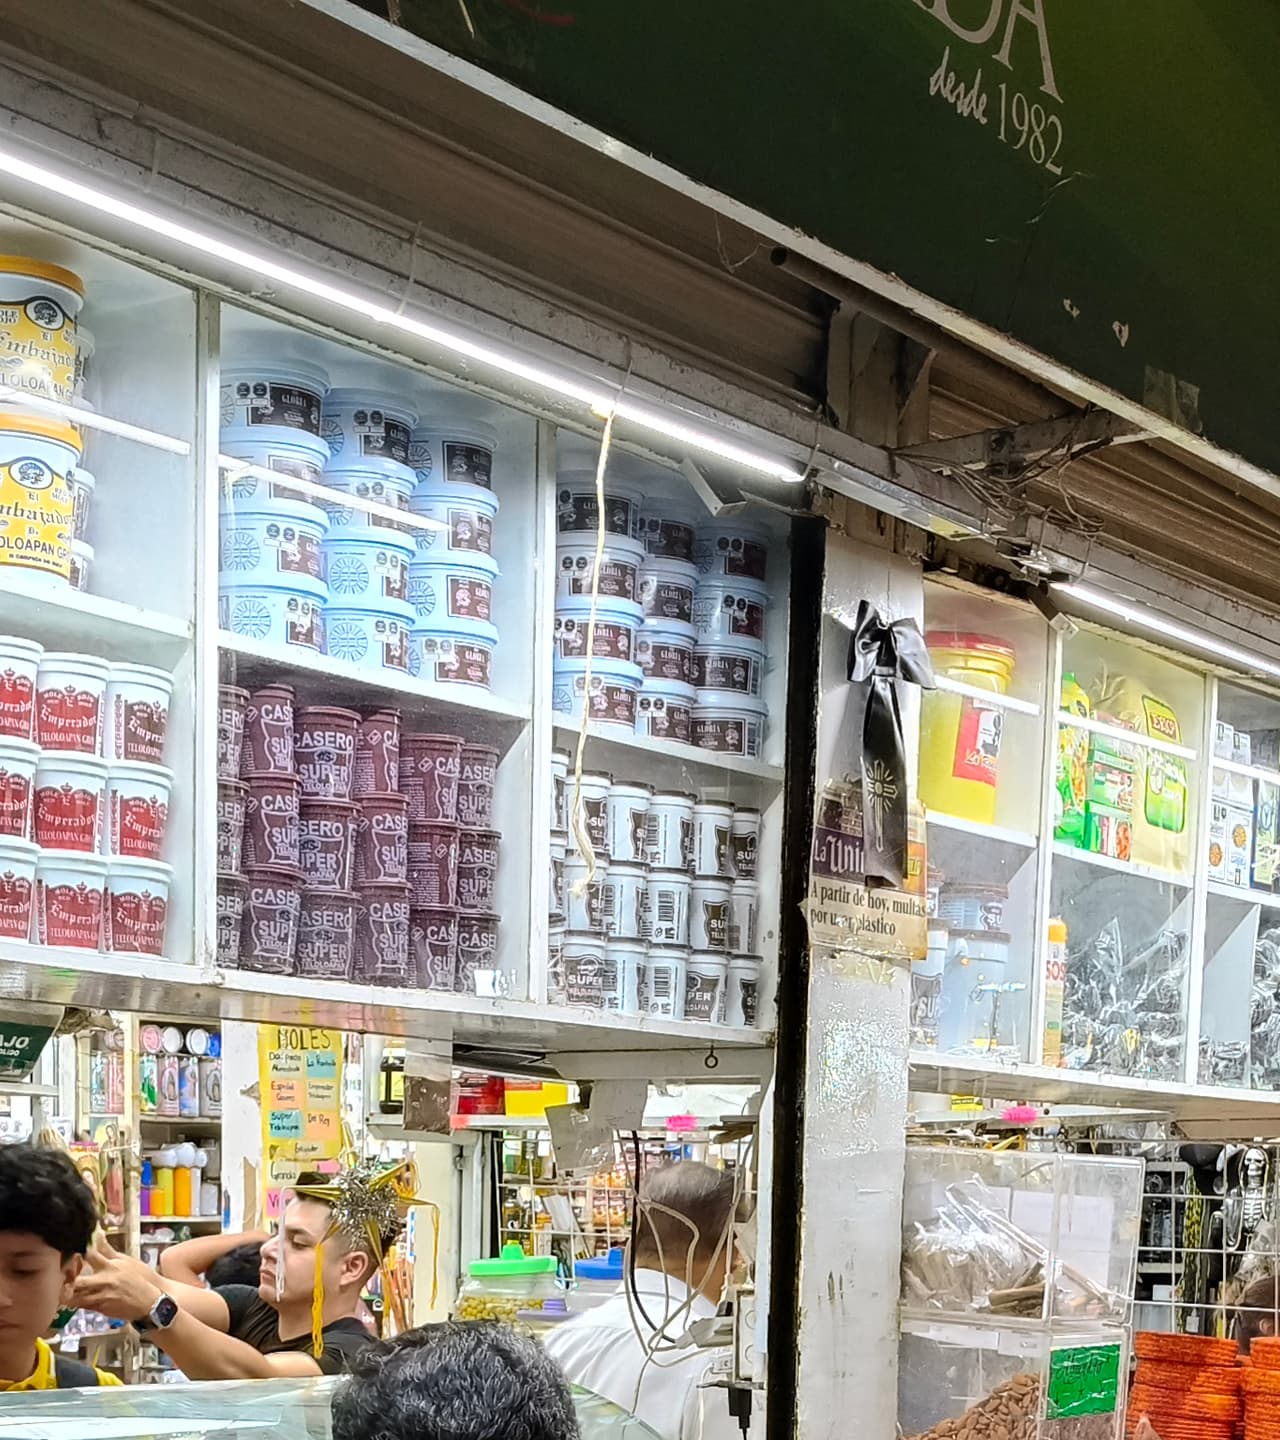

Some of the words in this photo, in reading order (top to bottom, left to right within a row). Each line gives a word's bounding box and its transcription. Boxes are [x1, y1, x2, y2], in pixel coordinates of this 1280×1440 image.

[929, 46, 987, 125] desde
[997, 83, 1063, 176] 1982
[40, 703, 98, 728] Emperador
[293, 730, 354, 750] CASERO
[299, 763, 348, 782] SUPER
[37, 802, 96, 828] Emperador
[814, 838, 827, 862] La
[810, 884, 819, 899] A
[820, 886, 851, 907] partir
[852, 888, 866, 905] de
[867, 890, 891, 913] hoy,
[892, 893, 927, 918] multas
[810, 908, 828, 926] por
[298, 942, 347, 959] SUPER
